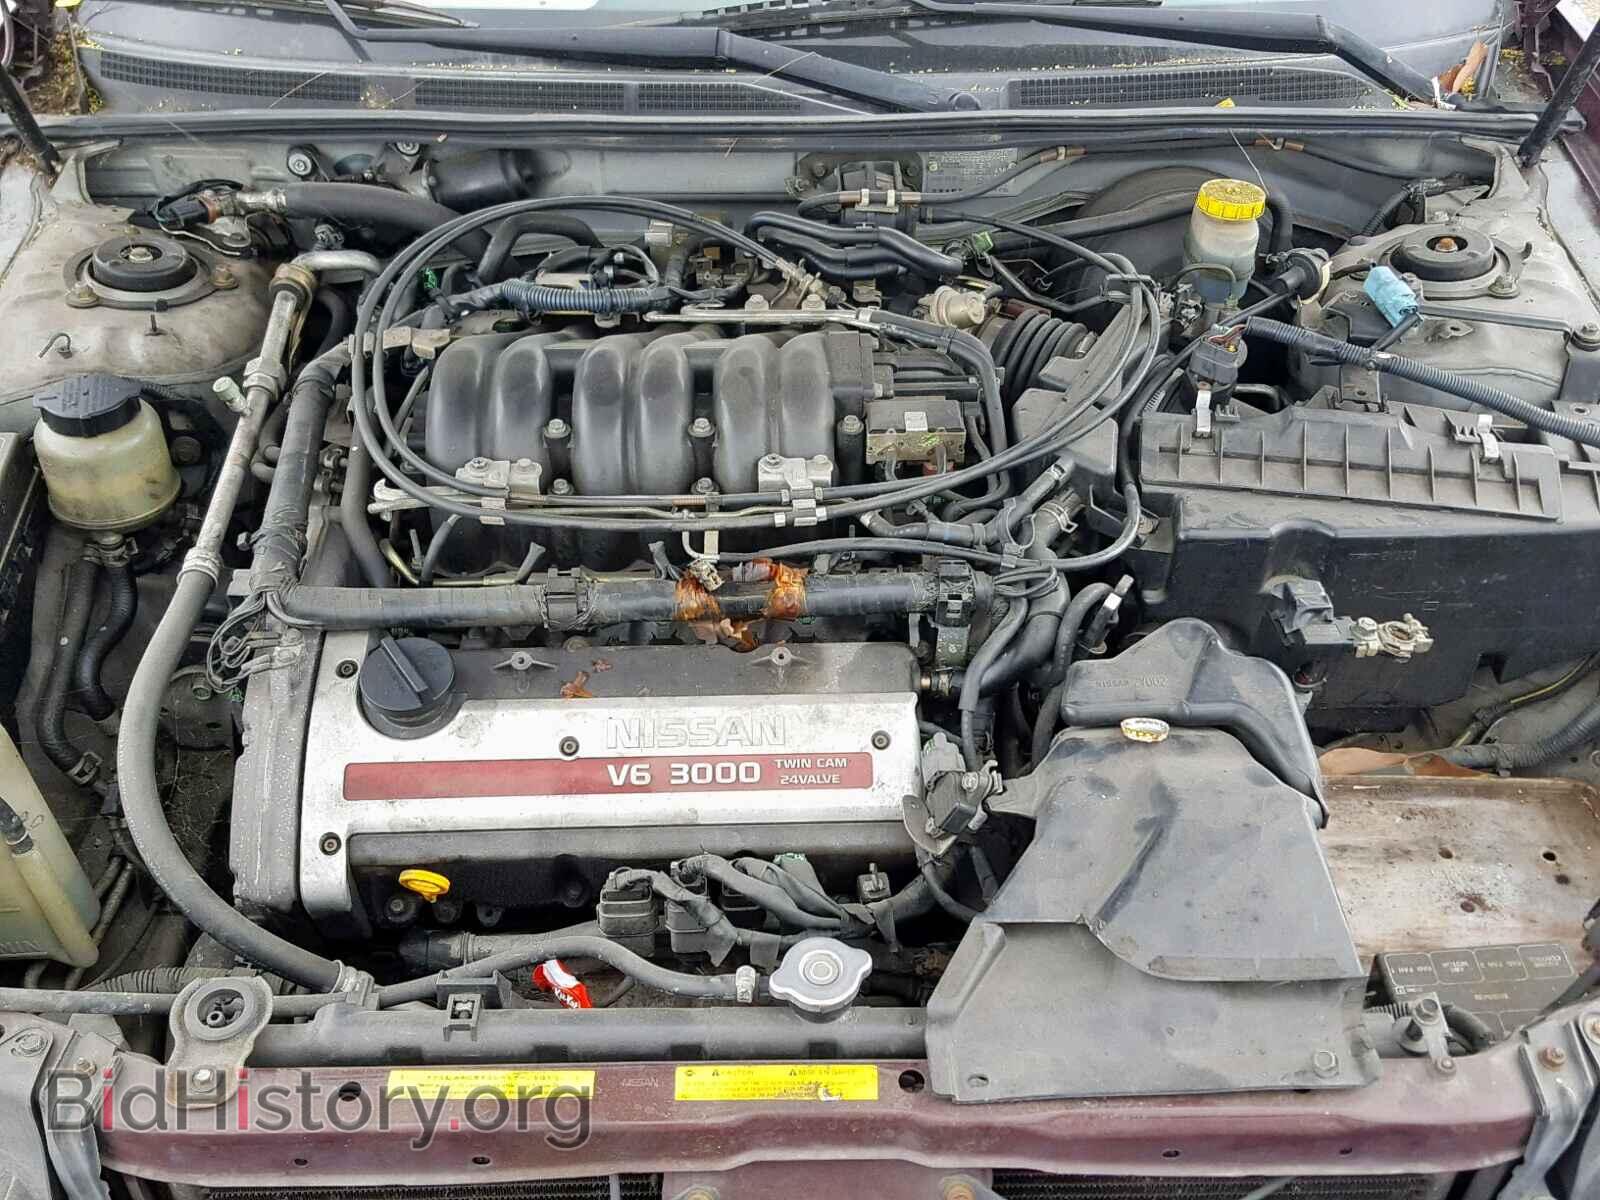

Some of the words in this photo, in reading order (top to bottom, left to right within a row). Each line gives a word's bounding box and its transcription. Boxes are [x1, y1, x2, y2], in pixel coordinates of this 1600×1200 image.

[606, 714, 786, 749] NISSAN
[775, 758, 812, 769] TWIN
[817, 757, 848, 768] CAM
[607, 763, 651, 786] V6
[670, 762, 761, 785] 3000
[780, 773, 841, 785] 24VALVE
